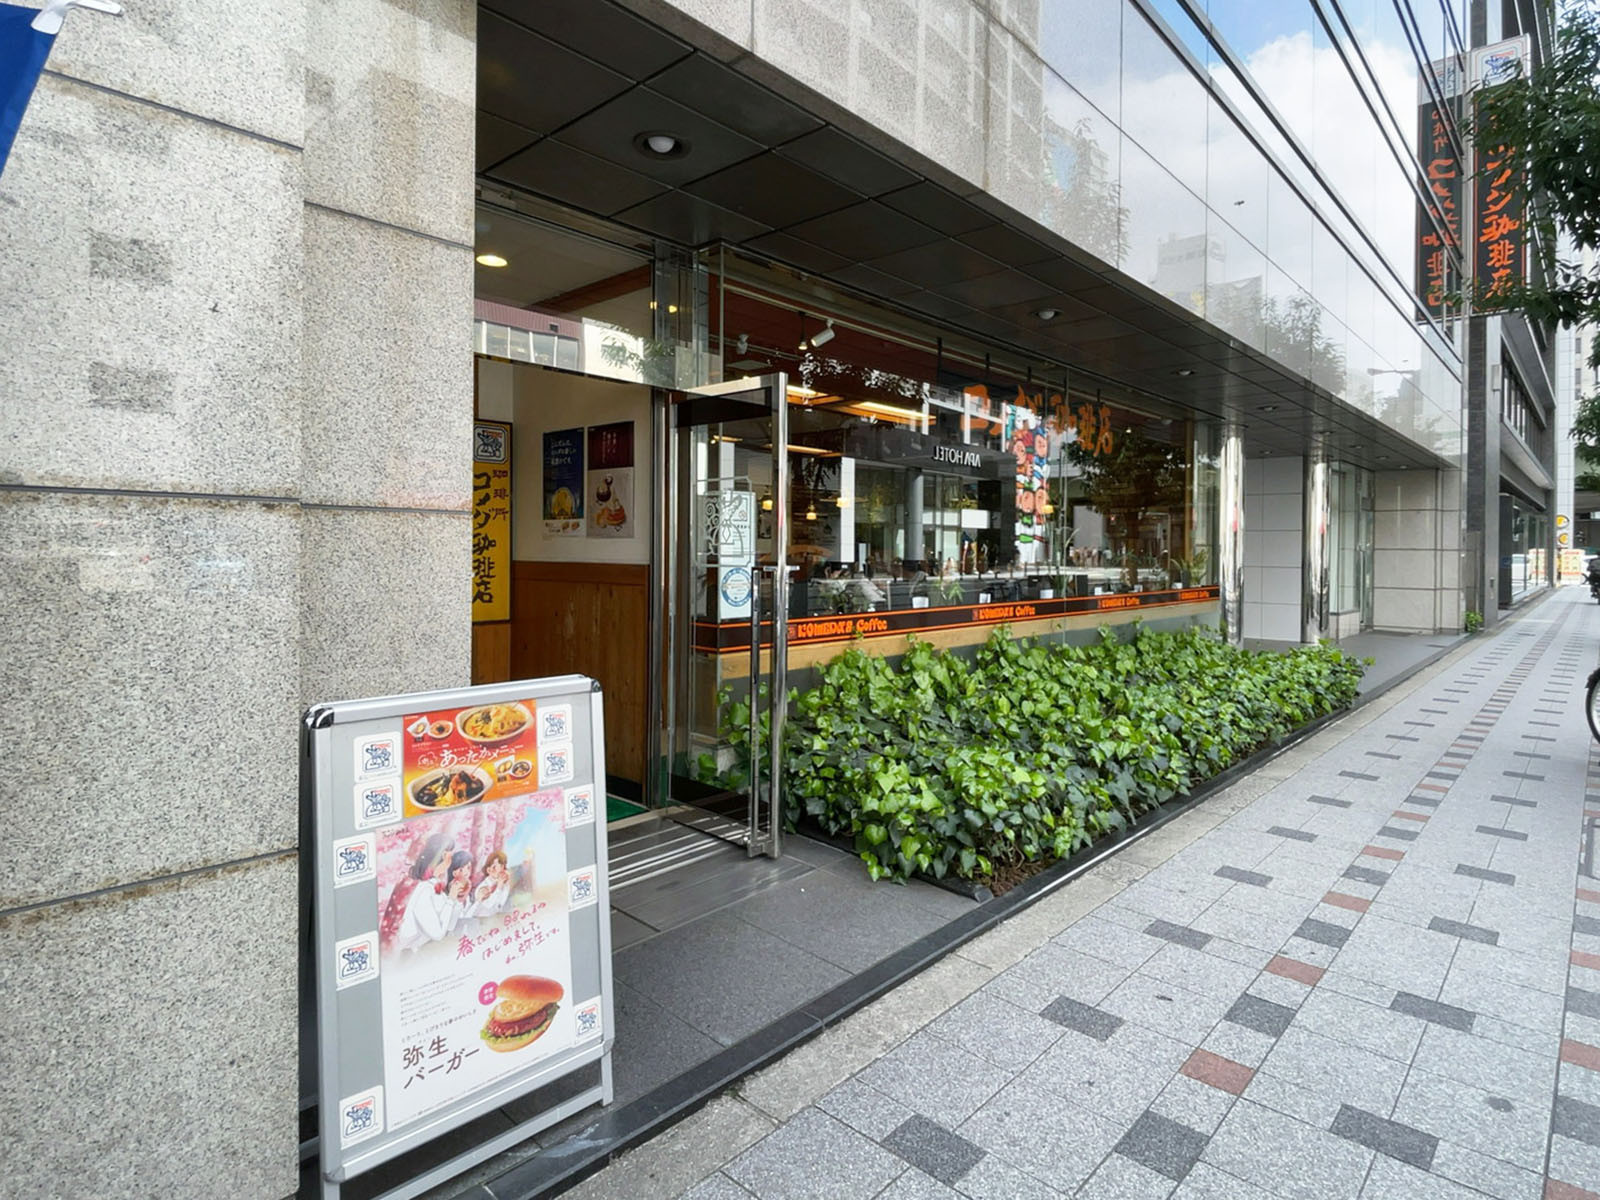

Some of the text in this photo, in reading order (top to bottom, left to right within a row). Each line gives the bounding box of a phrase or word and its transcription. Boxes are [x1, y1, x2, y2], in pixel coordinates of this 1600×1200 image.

[960, 384, 1113, 457] コダ珈琲店
[856, 617, 888, 633] Coffee
[440, 744, 524, 768] あったかメニュー
[402, 1035, 449, 1070] 弥生
[403, 1047, 480, 1090] バーガー
